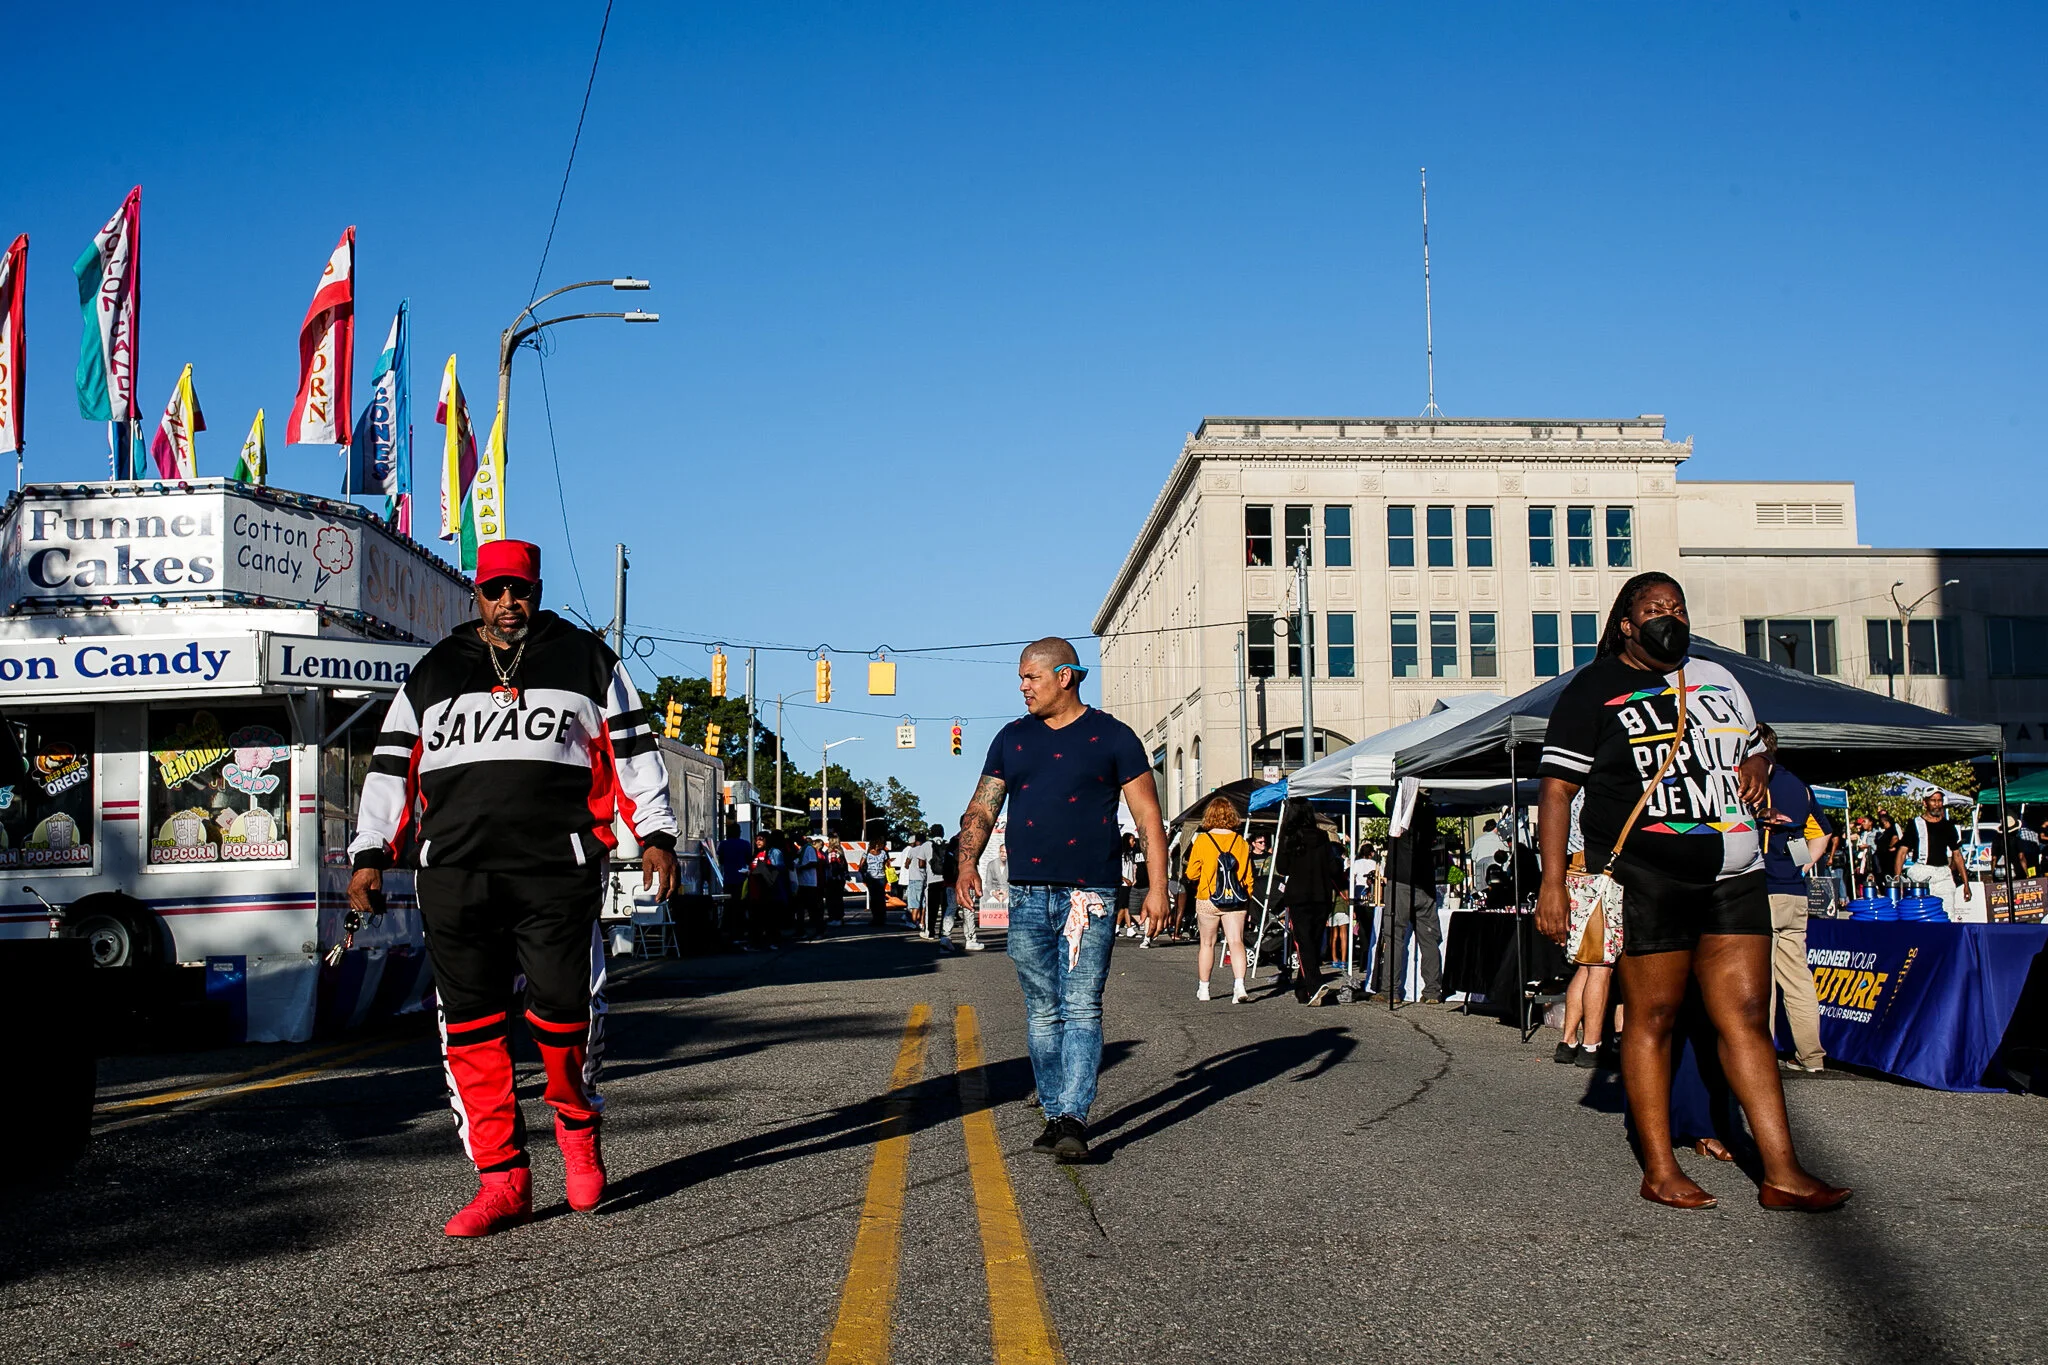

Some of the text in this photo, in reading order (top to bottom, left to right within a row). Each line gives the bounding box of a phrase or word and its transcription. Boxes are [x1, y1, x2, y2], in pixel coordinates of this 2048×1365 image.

[370, 386, 390, 481] CONES
[29, 508, 214, 541] Funnel
[233, 513, 307, 548] Cotton
[27, 545, 215, 589] Cakes
[237, 547, 302, 583] Candy
[74, 642, 231, 681] Candy
[280, 644, 411, 683] Lemona
[427, 707, 577, 751] SAVAGE
[45, 761, 81, 783] DEEP FRIED
[160, 735, 229, 786] LEMONADE
[47, 767, 88, 796] OREOS
[225, 767, 276, 792] CANDY
[152, 839, 176, 848] Fresh
[153, 845, 215, 861] POPCORN
[224, 834, 247, 843] Fresh
[224, 843, 286, 857] POPCORN
[27, 847, 90, 863] POPCORN
[1807, 949, 1877, 970] ENGINEER YOUR
[1813, 967, 1888, 1010] FUTURE
[1824, 1006, 1842, 1019] YOUR
[1842, 1009, 1872, 1024] SUCCESS
